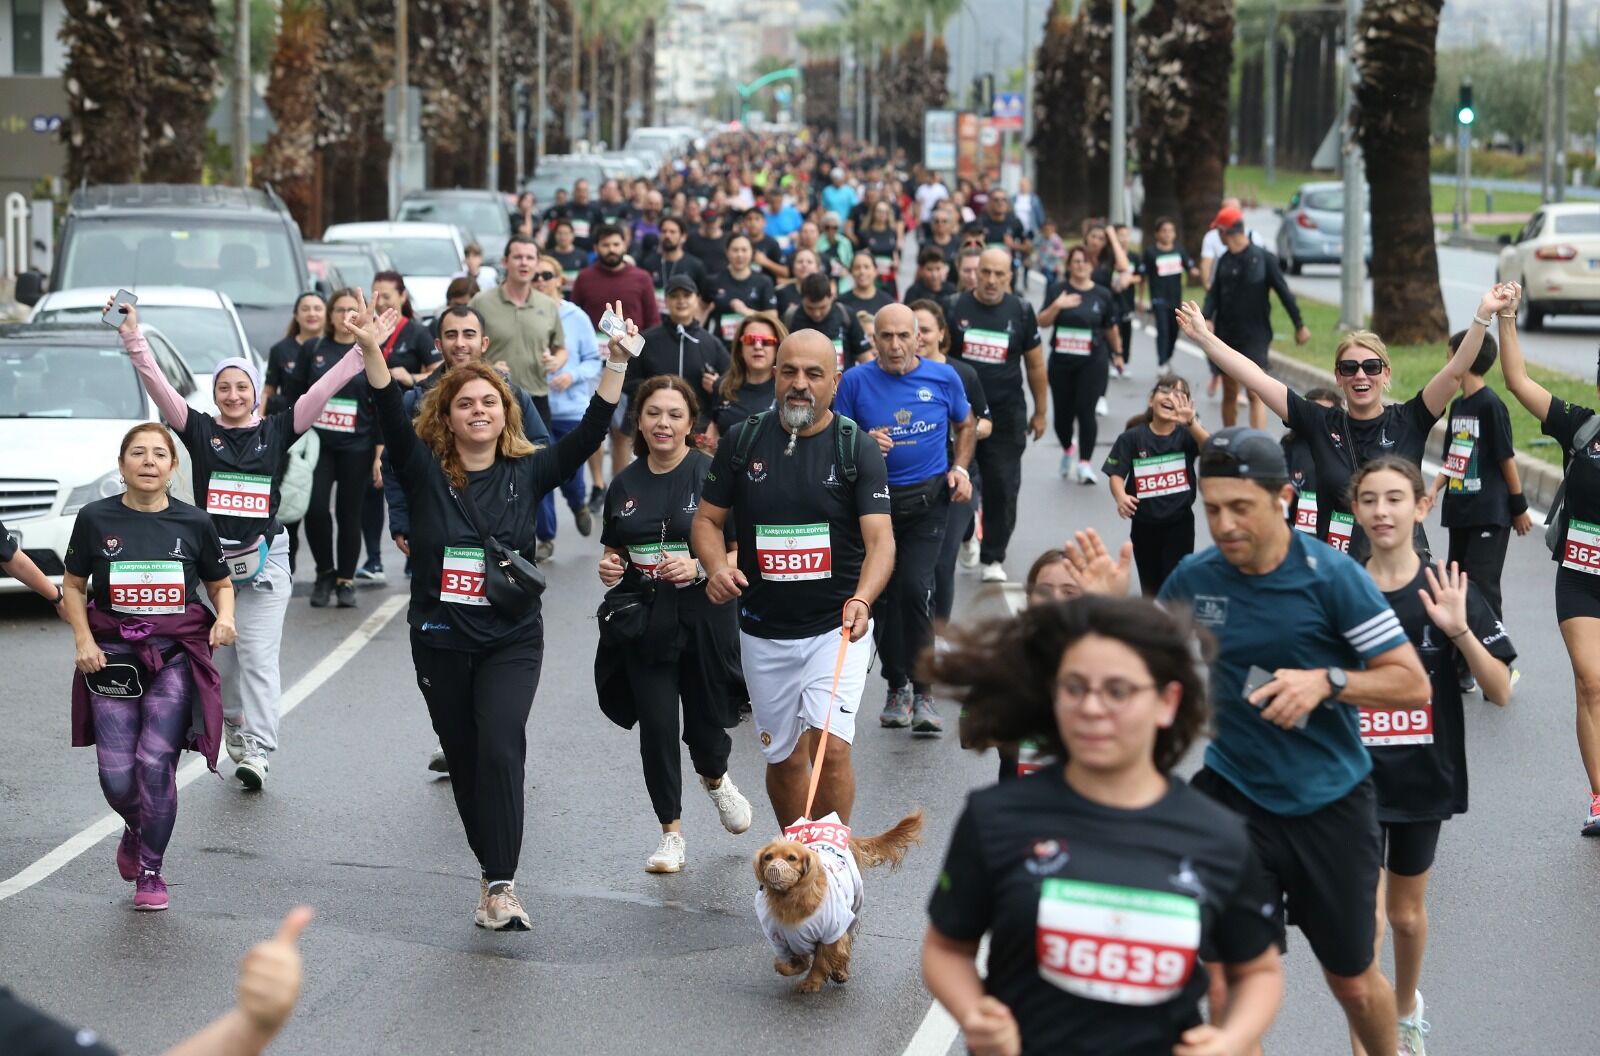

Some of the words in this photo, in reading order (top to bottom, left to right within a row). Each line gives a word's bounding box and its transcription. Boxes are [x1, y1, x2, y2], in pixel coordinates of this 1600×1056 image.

[317, 412, 353, 426] 6478
[1138, 472, 1186, 490] 36495
[209, 492, 266, 510] 36680
[763, 552, 824, 571] 35817
[1568, 544, 1600, 565] 362
[446, 573, 485, 593] 357
[113, 588, 181, 603] 35969
[1042, 933, 1186, 986] 36639
